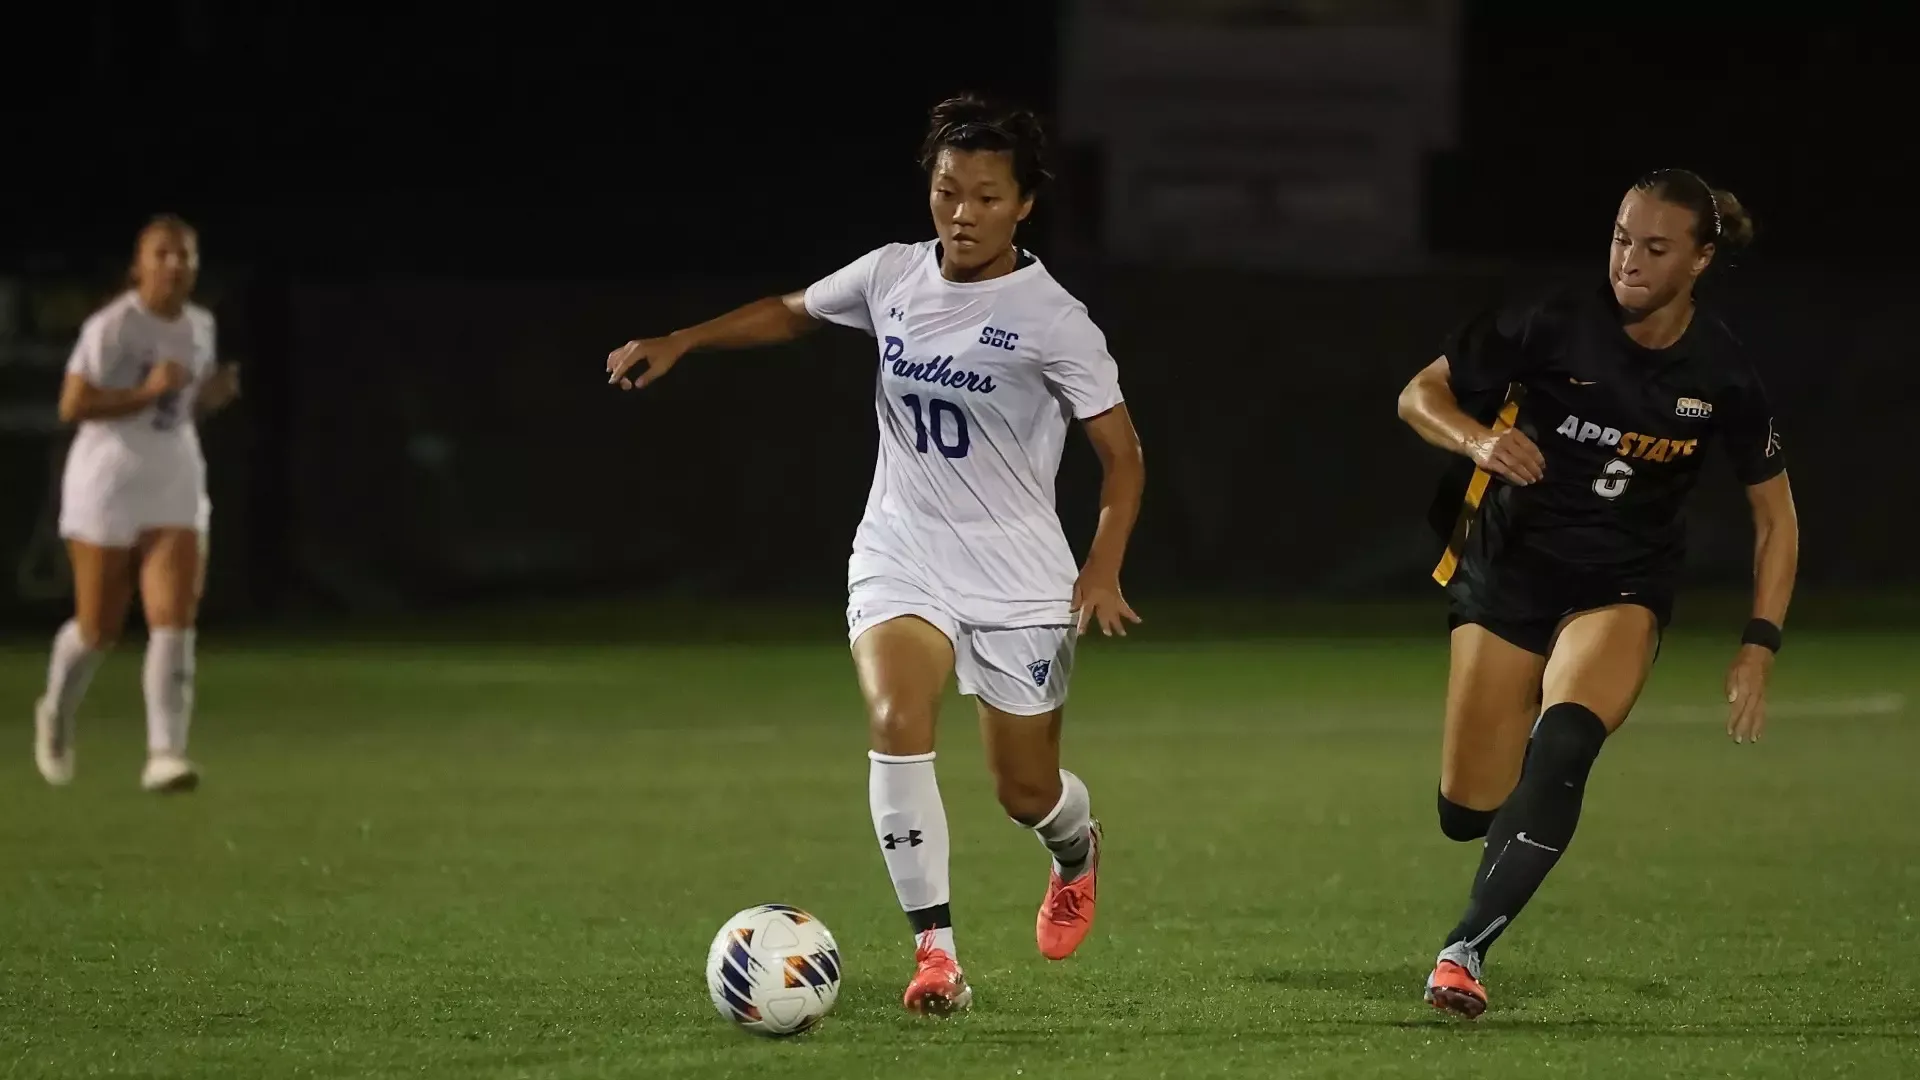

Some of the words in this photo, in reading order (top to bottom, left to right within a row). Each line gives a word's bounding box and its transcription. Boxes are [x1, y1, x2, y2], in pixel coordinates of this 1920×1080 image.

[882, 335, 997, 393] Panthers
[979, 326, 1019, 351] SBC
[901, 393, 970, 459] 10
